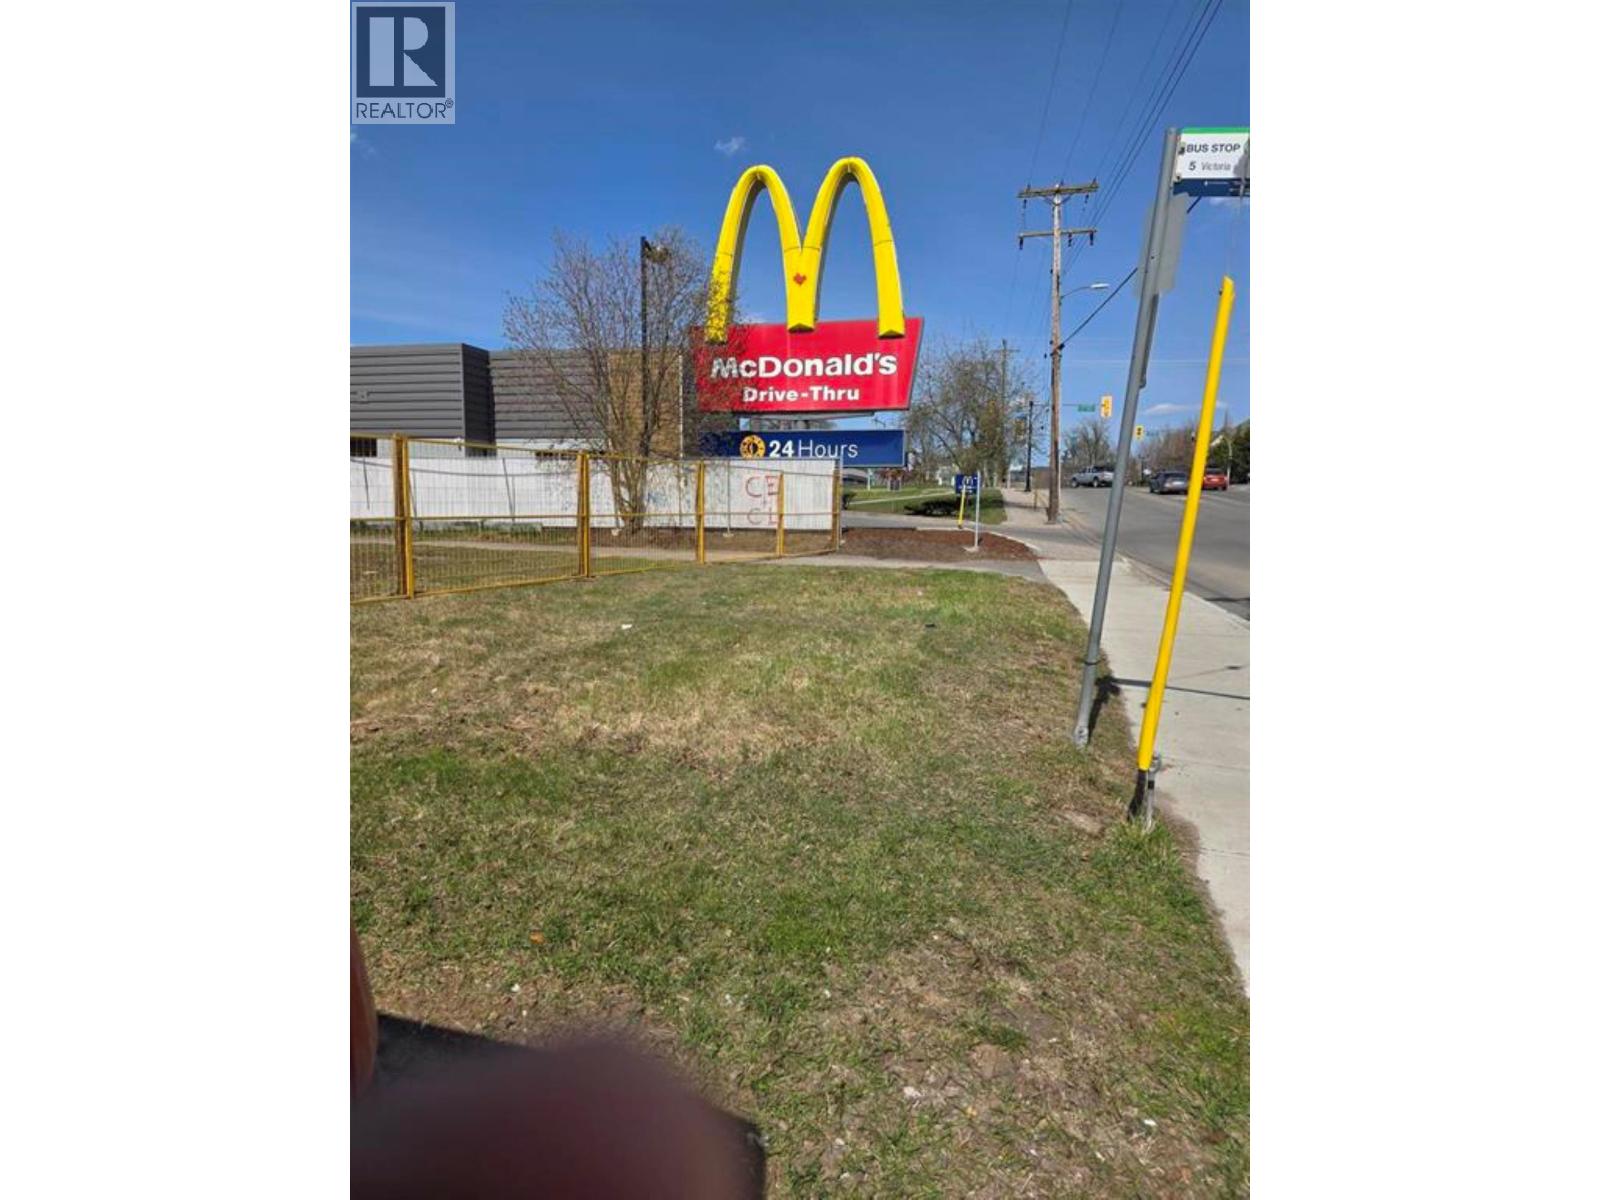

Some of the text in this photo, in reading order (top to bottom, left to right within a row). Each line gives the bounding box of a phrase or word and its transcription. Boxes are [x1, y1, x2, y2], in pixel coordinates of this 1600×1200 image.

[1186, 143, 1241, 154] BUS STOP
[1188, 161, 1232, 171] 5 Victoria
[710, 351, 898, 379] McDonald's
[742, 385, 860, 403] Drive-Thru
[768, 439, 859, 459] 24 Hours
